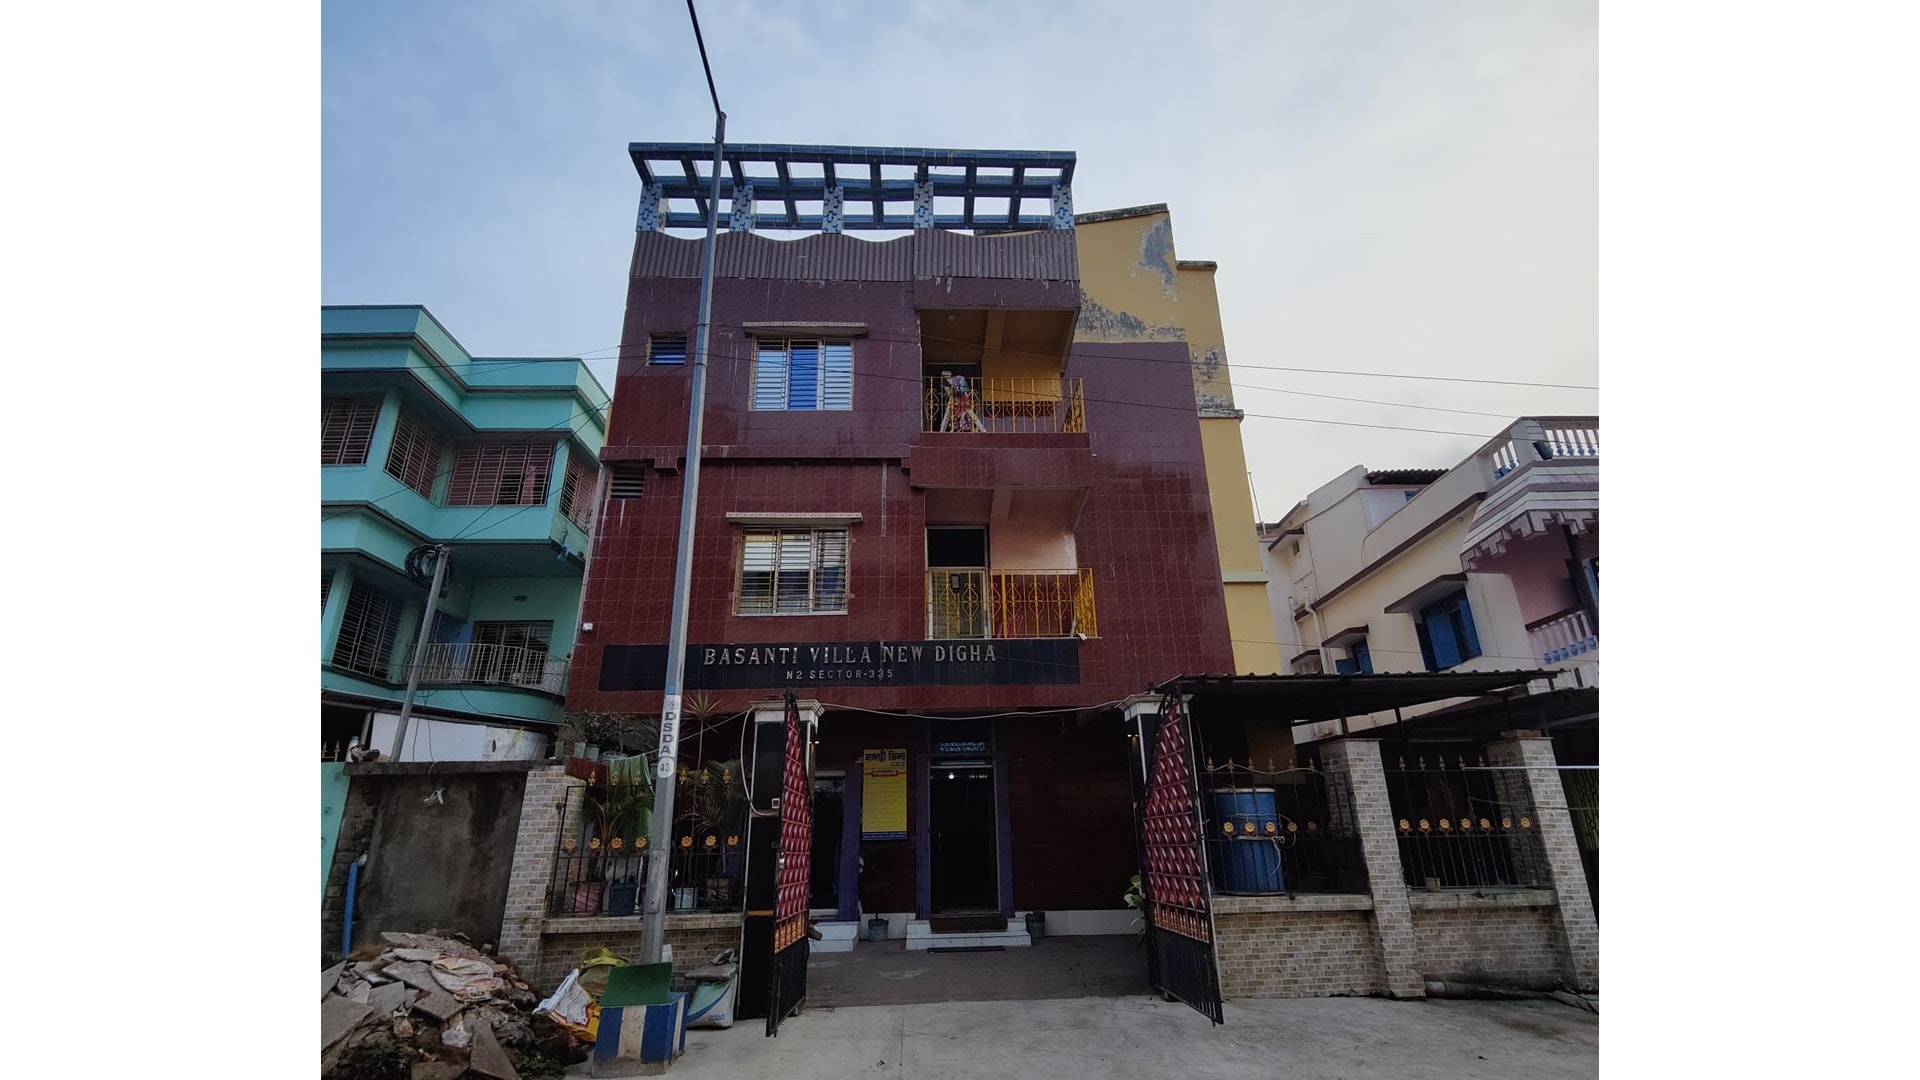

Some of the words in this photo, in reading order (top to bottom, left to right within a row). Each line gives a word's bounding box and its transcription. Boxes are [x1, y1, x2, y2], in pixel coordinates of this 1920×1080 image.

[703, 646, 799, 666] BASANTI
[809, 645, 871, 664] VILLA
[881, 645, 923, 663] NEW
[934, 644, 997, 662] DIGHA
[786, 670, 803, 680] N2
[660, 711, 676, 755] DSDA
